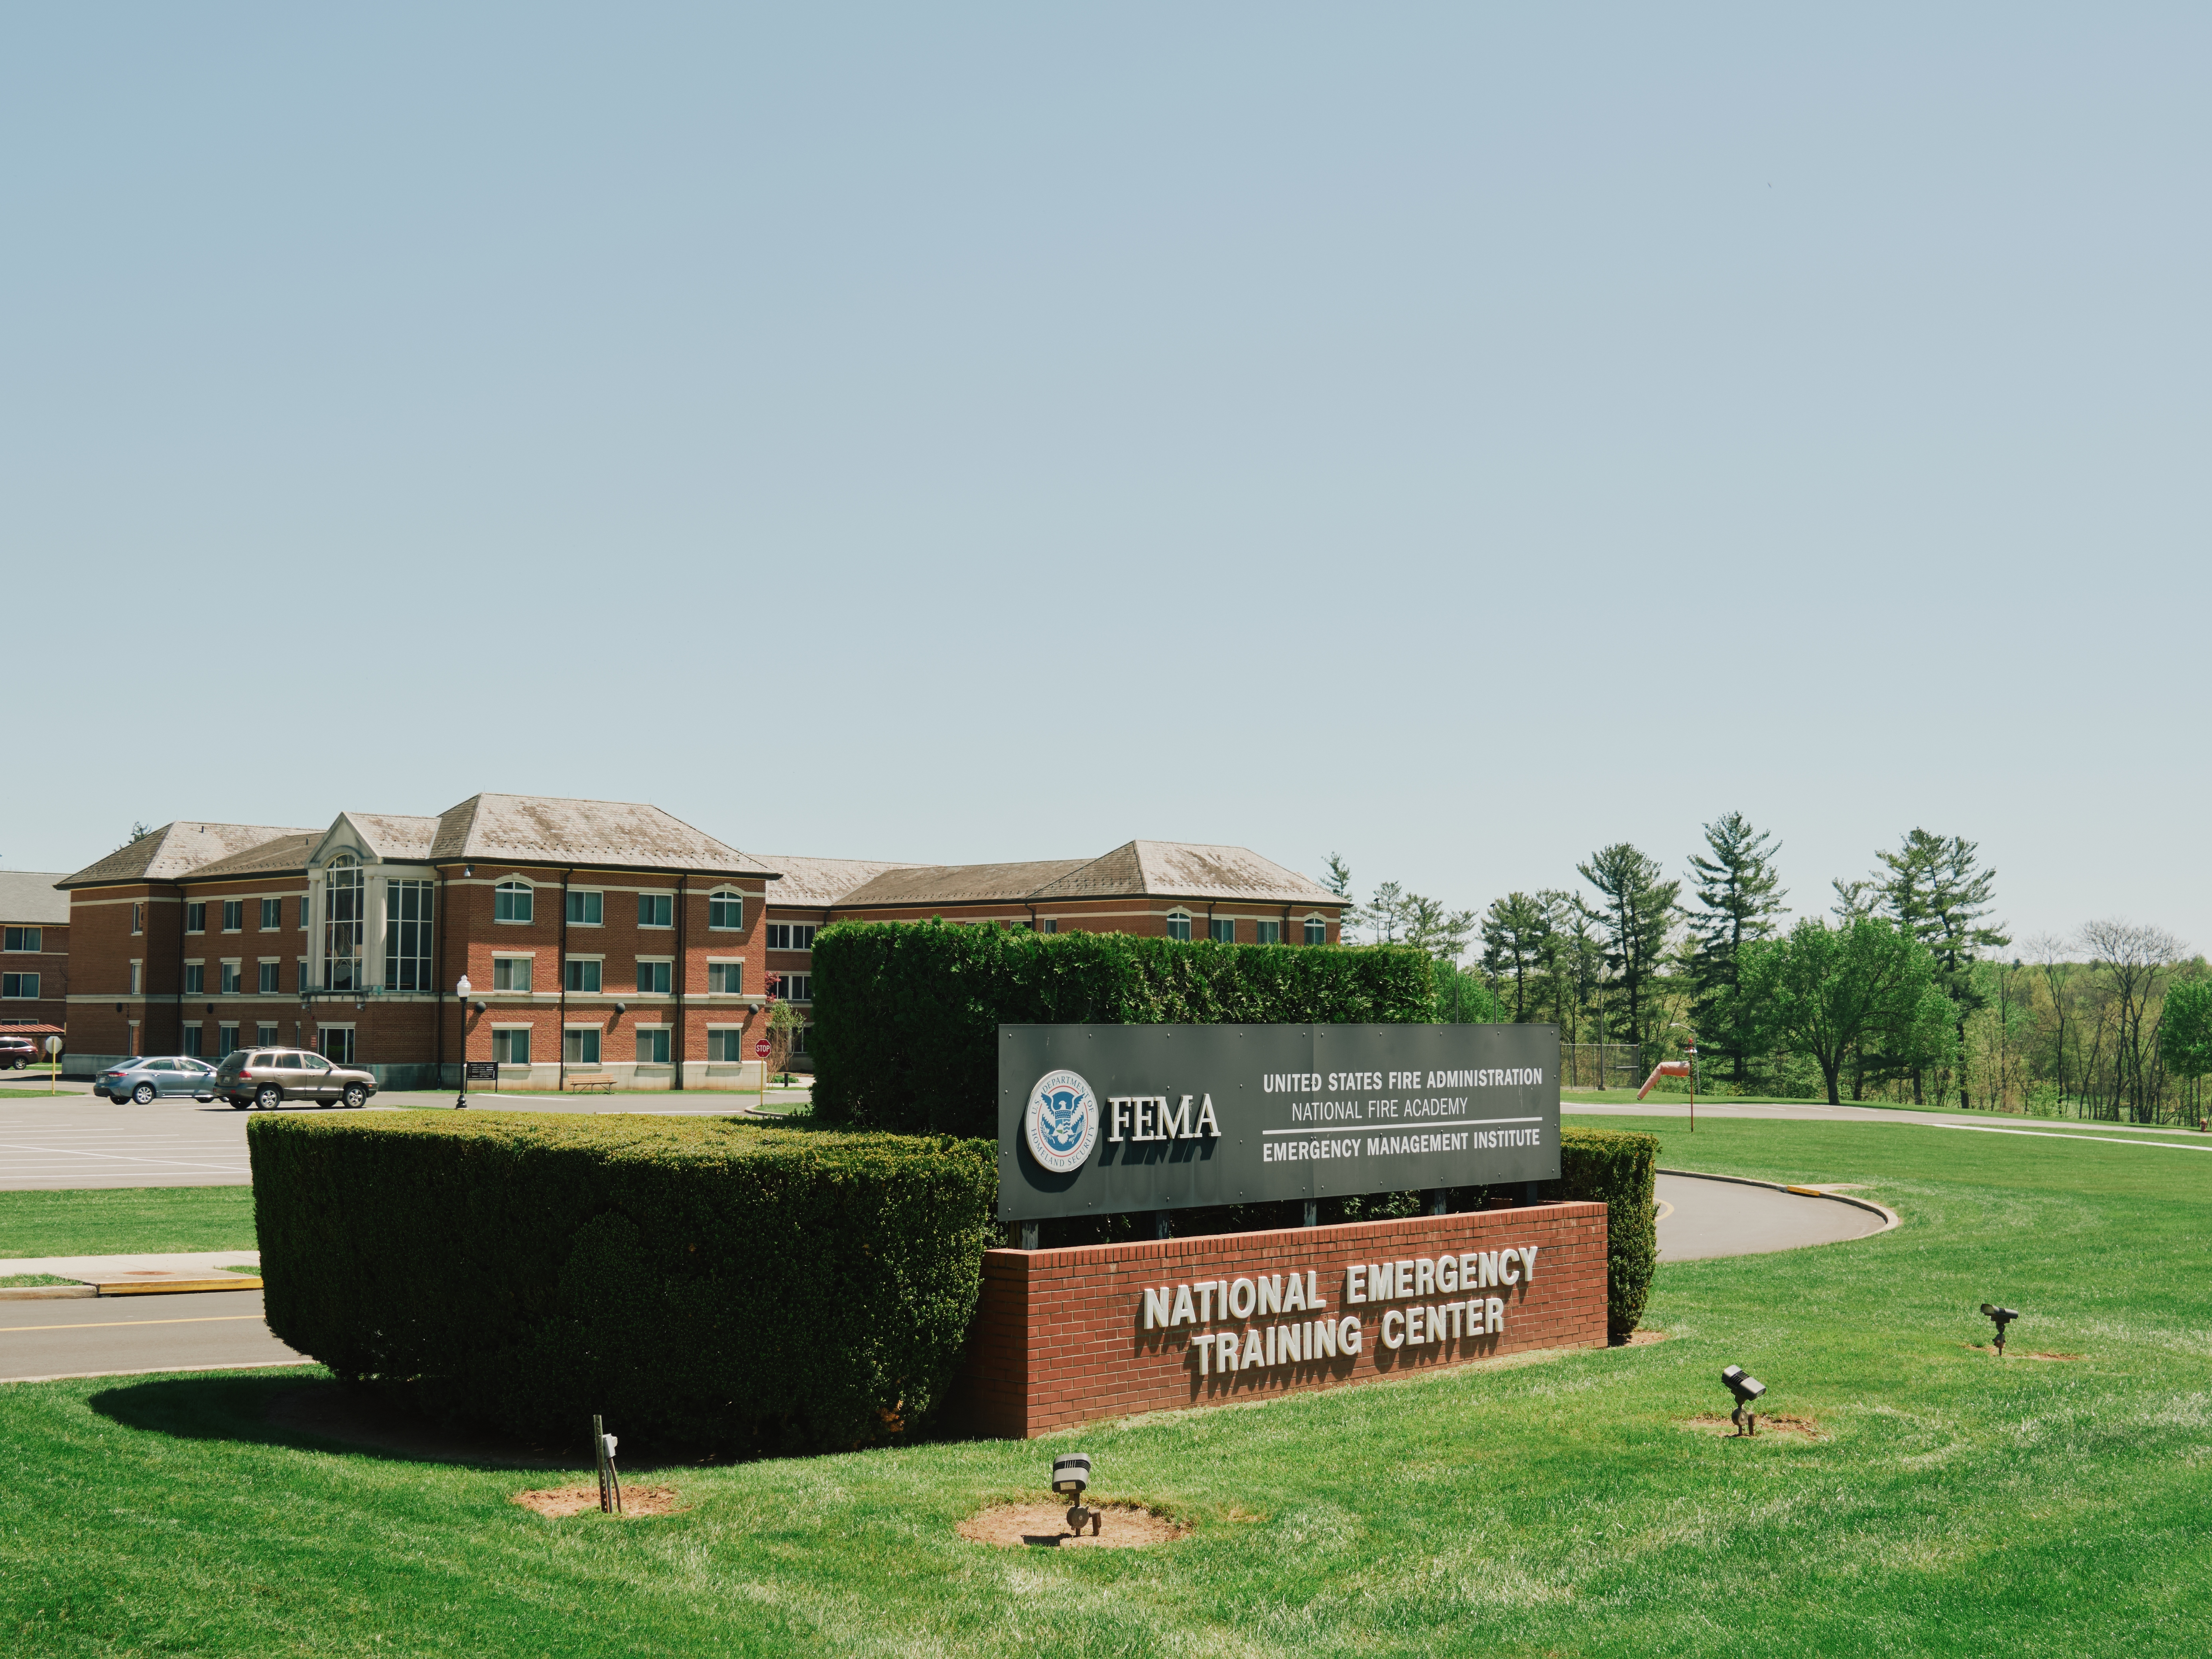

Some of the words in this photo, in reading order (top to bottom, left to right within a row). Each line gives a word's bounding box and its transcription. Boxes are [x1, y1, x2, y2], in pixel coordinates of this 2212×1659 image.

[1032, 1099, 1041, 1114] U.S.
[1042, 1076, 1090, 1099] DEPARTMENT
[1087, 1100, 1094, 1113] OF
[1264, 1073, 1322, 1092] UNITED
[1328, 1072, 1382, 1091] STATES
[1389, 1071, 1421, 1089] FIRE
[1427, 1068, 1542, 1088] ADMINISTRATION
[1107, 1094, 1221, 1142] FEMA
[1292, 1101, 1362, 1121] NATIONAL
[1369, 1100, 1398, 1118] FIRE
[1404, 1097, 1468, 1117] ACADEMY
[1031, 1129, 1064, 1166] HOMELAND
[1068, 1124, 1094, 1166] SECURITY
[1263, 1139, 1361, 1162] EMERGENCY
[1367, 1133, 1468, 1156] MANAGEMENT
[1474, 1129, 1540, 1149] INSTITUTE
[1144, 1271, 1326, 1330] NATIONAL
[1347, 1246, 1538, 1304] EMERGENCY
[1191, 1316, 1362, 1375] TRAINING
[1381, 1298, 1504, 1349] CENTER
